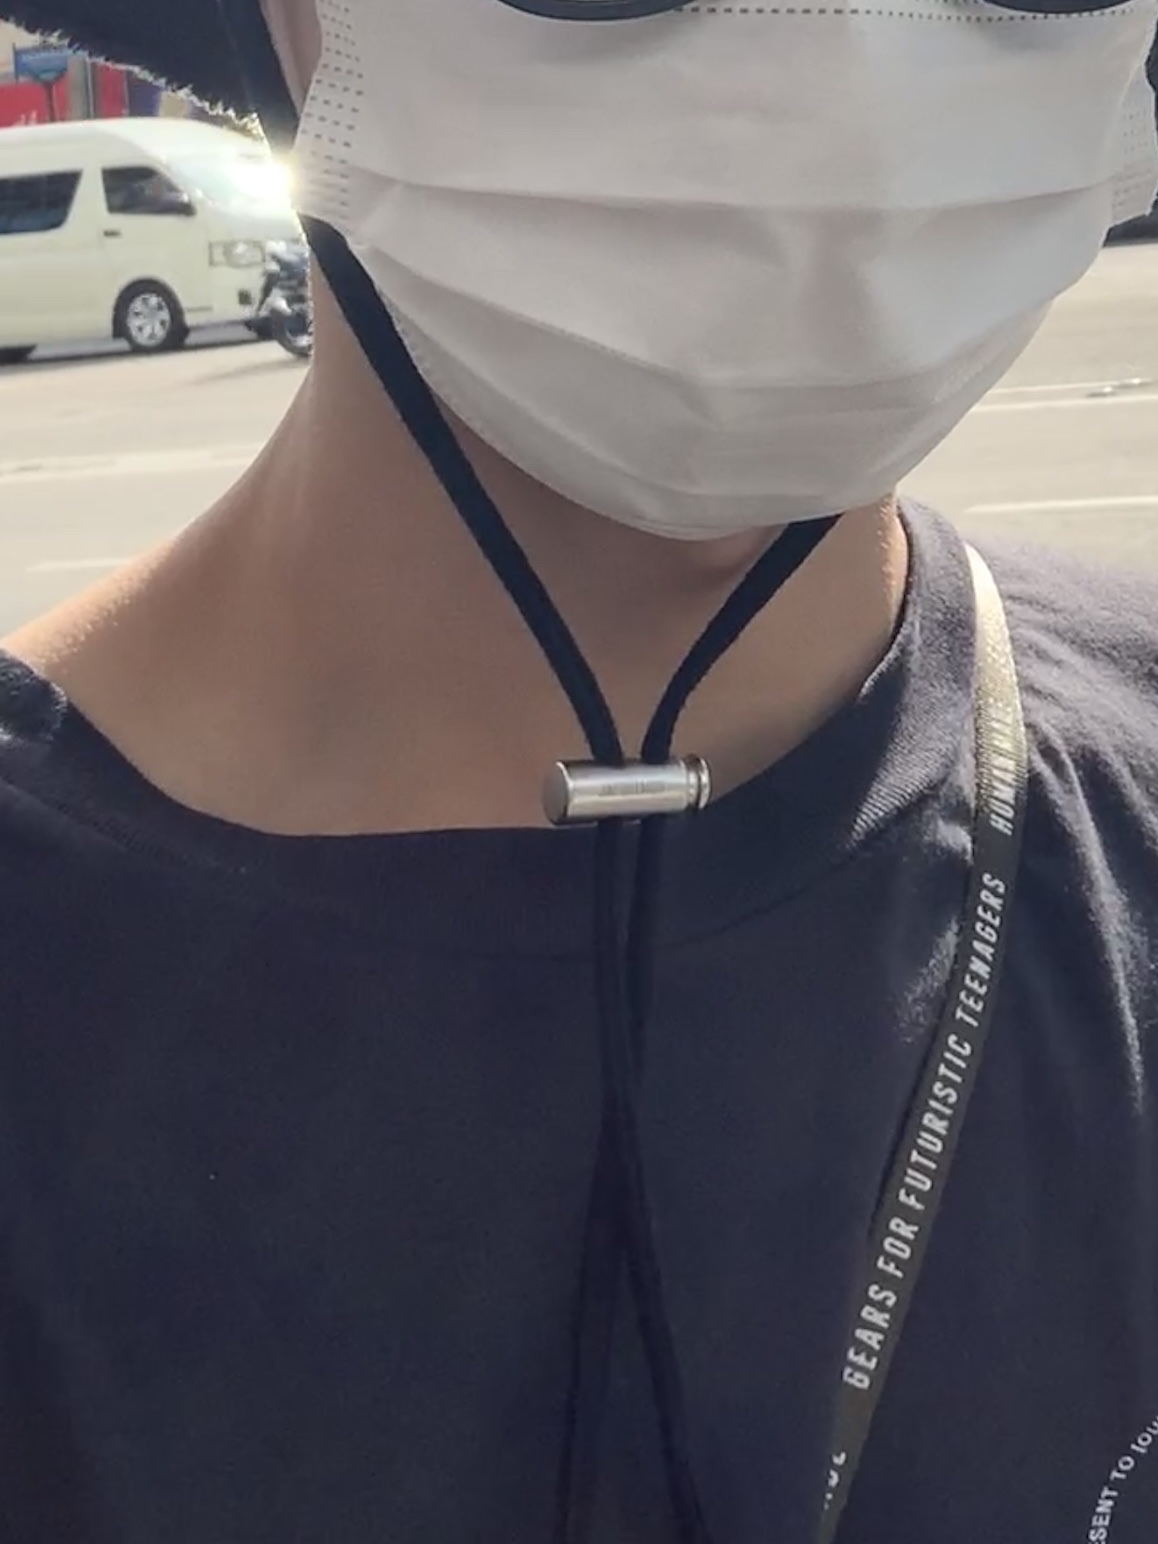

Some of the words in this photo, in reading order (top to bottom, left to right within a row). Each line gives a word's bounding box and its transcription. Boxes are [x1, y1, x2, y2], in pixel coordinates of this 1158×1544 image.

[842, 1284, 898, 1391] GEARS
[876, 1217, 919, 1279] FOR
[898, 1032, 973, 1212] FUTURISTIC
[955, 872, 1005, 1028] TEENAGERS
[1109, 1455, 1135, 1481] TO
